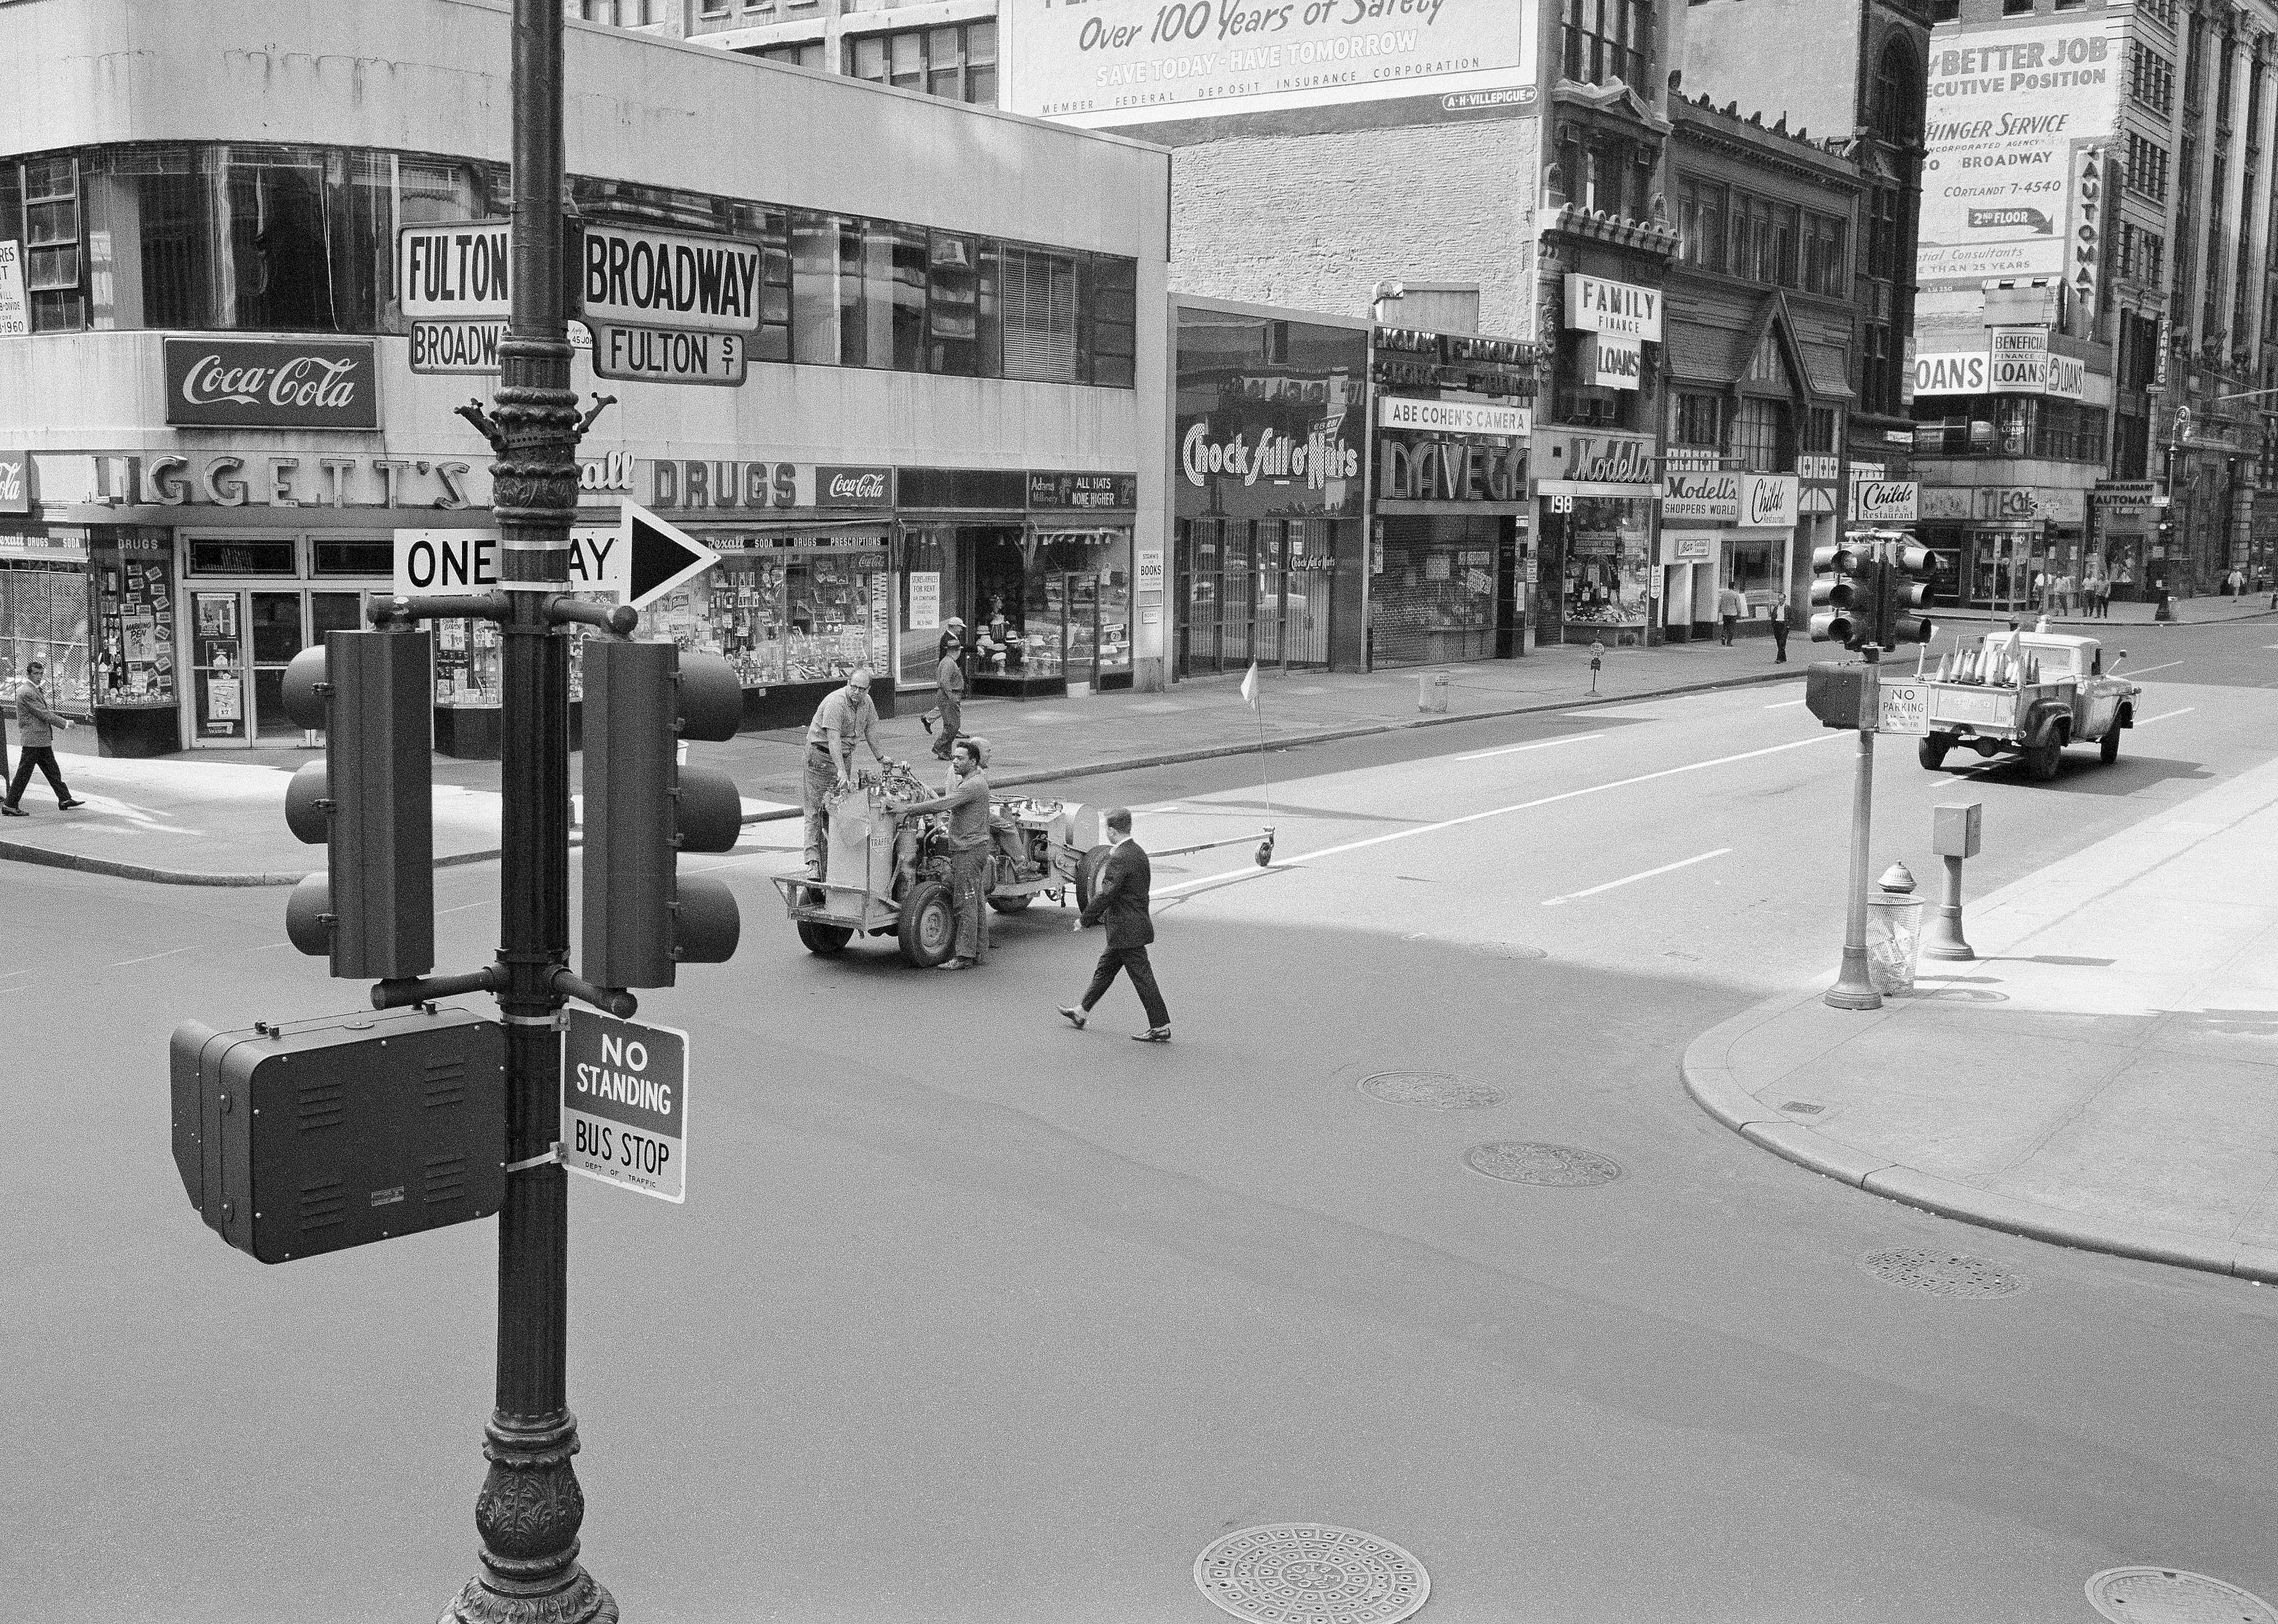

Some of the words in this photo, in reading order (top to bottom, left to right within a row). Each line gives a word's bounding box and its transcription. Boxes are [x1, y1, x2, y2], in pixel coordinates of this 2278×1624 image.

[1079, 17, 1143, 51] Over
[1150, 2, 1211, 43] 100
[1218, 0, 1294, 41] Years
[1303, 0, 1337, 25] of
[1096, 61, 1147, 87] SAVE
[1151, 53, 1216, 81] TODAY
[1230, 45, 1282, 72] HAVE
[1287, 29, 1418, 65] TOMORROW
[1941, 43, 2045, 77] BETTER
[2048, 37, 2108, 66] JOB
[1042, 101, 1094, 113] MEMBER
[1115, 92, 1175, 106] FEDERAL
[1198, 82, 1260, 97] DEPOSIT
[1276, 71, 1357, 89] INSURANCE
[1373, 57, 1479, 78] CORPORATION
[1996, 113, 2070, 136] SERVICE
[1962, 151, 2053, 169] BROADWAY
[2010, 180, 2061, 194] 7-4540
[1993, 212, 2029, 224] FLOOR
[2076, 161, 2101, 304] AUTOMAT
[409, 232, 508, 301] FULTON
[1951, 248, 2024, 261] Consultants
[585, 234, 758, 318] BROADWAY
[1930, 263, 1967, 273] THAN
[1973, 263, 1986, 272] 25
[1992, 261, 2030, 270] YEARS
[1583, 281, 1655, 320] FAMILY
[1599, 316, 1639, 334] FINANCE
[414, 325, 508, 366] BROADW
[572, 336, 580, 344] 45
[611, 330, 708, 374] FULTON
[722, 336, 734, 376] ST
[1597, 345, 1640, 377] LOANS
[1994, 352, 2034, 360] FINANCE
[182, 354, 359, 407] Coca-Cola
[1993, 362, 2045, 382] LOANS
[2060, 361, 2082, 395] LOANS
[1393, 404, 1418, 422] ABE
[1421, 406, 1473, 427] COHEN'S
[1476, 411, 1525, 430] CAMERA
[1182, 423, 1249, 486] Chock
[1244, 427, 1288, 486] full
[92, 455, 470, 510] LIGGETT'S
[574, 450, 635, 490] all
[652, 460, 797, 508] DRUGS
[1386, 440, 1530, 501] DAVEGA
[829, 473, 885, 498] Coca-Cola
[1076, 477, 1090, 489] ALL
[1092, 477, 1112, 490] HATS
[1664, 476, 1738, 500] Modell's
[1072, 492, 1090, 505] NONE
[1090, 492, 1115, 506] HIGHER
[1550, 495, 1573, 513] 198
[1751, 478, 1785, 524] Childs
[1863, 482, 1913, 511] Childs
[2095, 495, 2152, 504] AUTOMAT
[1664, 503, 1706, 514] SHOPPERS
[1709, 504, 1736, 516] WORLD
[1862, 510, 1914, 520] Restaurant
[1888, 505, 1909, 513] BAR
[27, 537, 49, 547] DRUGS
[62, 537, 81, 548] SODA
[117, 538, 159, 550] DRUGS
[707, 535, 744, 549] Rexall
[755, 537, 773, 549] SODA
[793, 536, 817, 547] DRUGS
[829, 536, 881, 546] PRESCRIPTIONS
[408, 540, 497, 587] ONE
[569, 537, 615, 581] AY
[858, 554, 885, 568] Coca-Cola
[1140, 564, 1162, 576] BOOKS
[913, 585, 923, 593] FOR
[924, 584, 936, 592] RENT
[1892, 689, 1915, 700] NO
[1882, 702, 1924, 713] PARKING
[601, 1033, 648, 1072] NO
[576, 1062, 672, 1115] STANDING
[576, 1118, 612, 1161] BUS
[620, 1132, 669, 1176] STOP
[584, 1160, 603, 1172] DEPT
[628, 1174, 657, 1188] TRAFFIC
